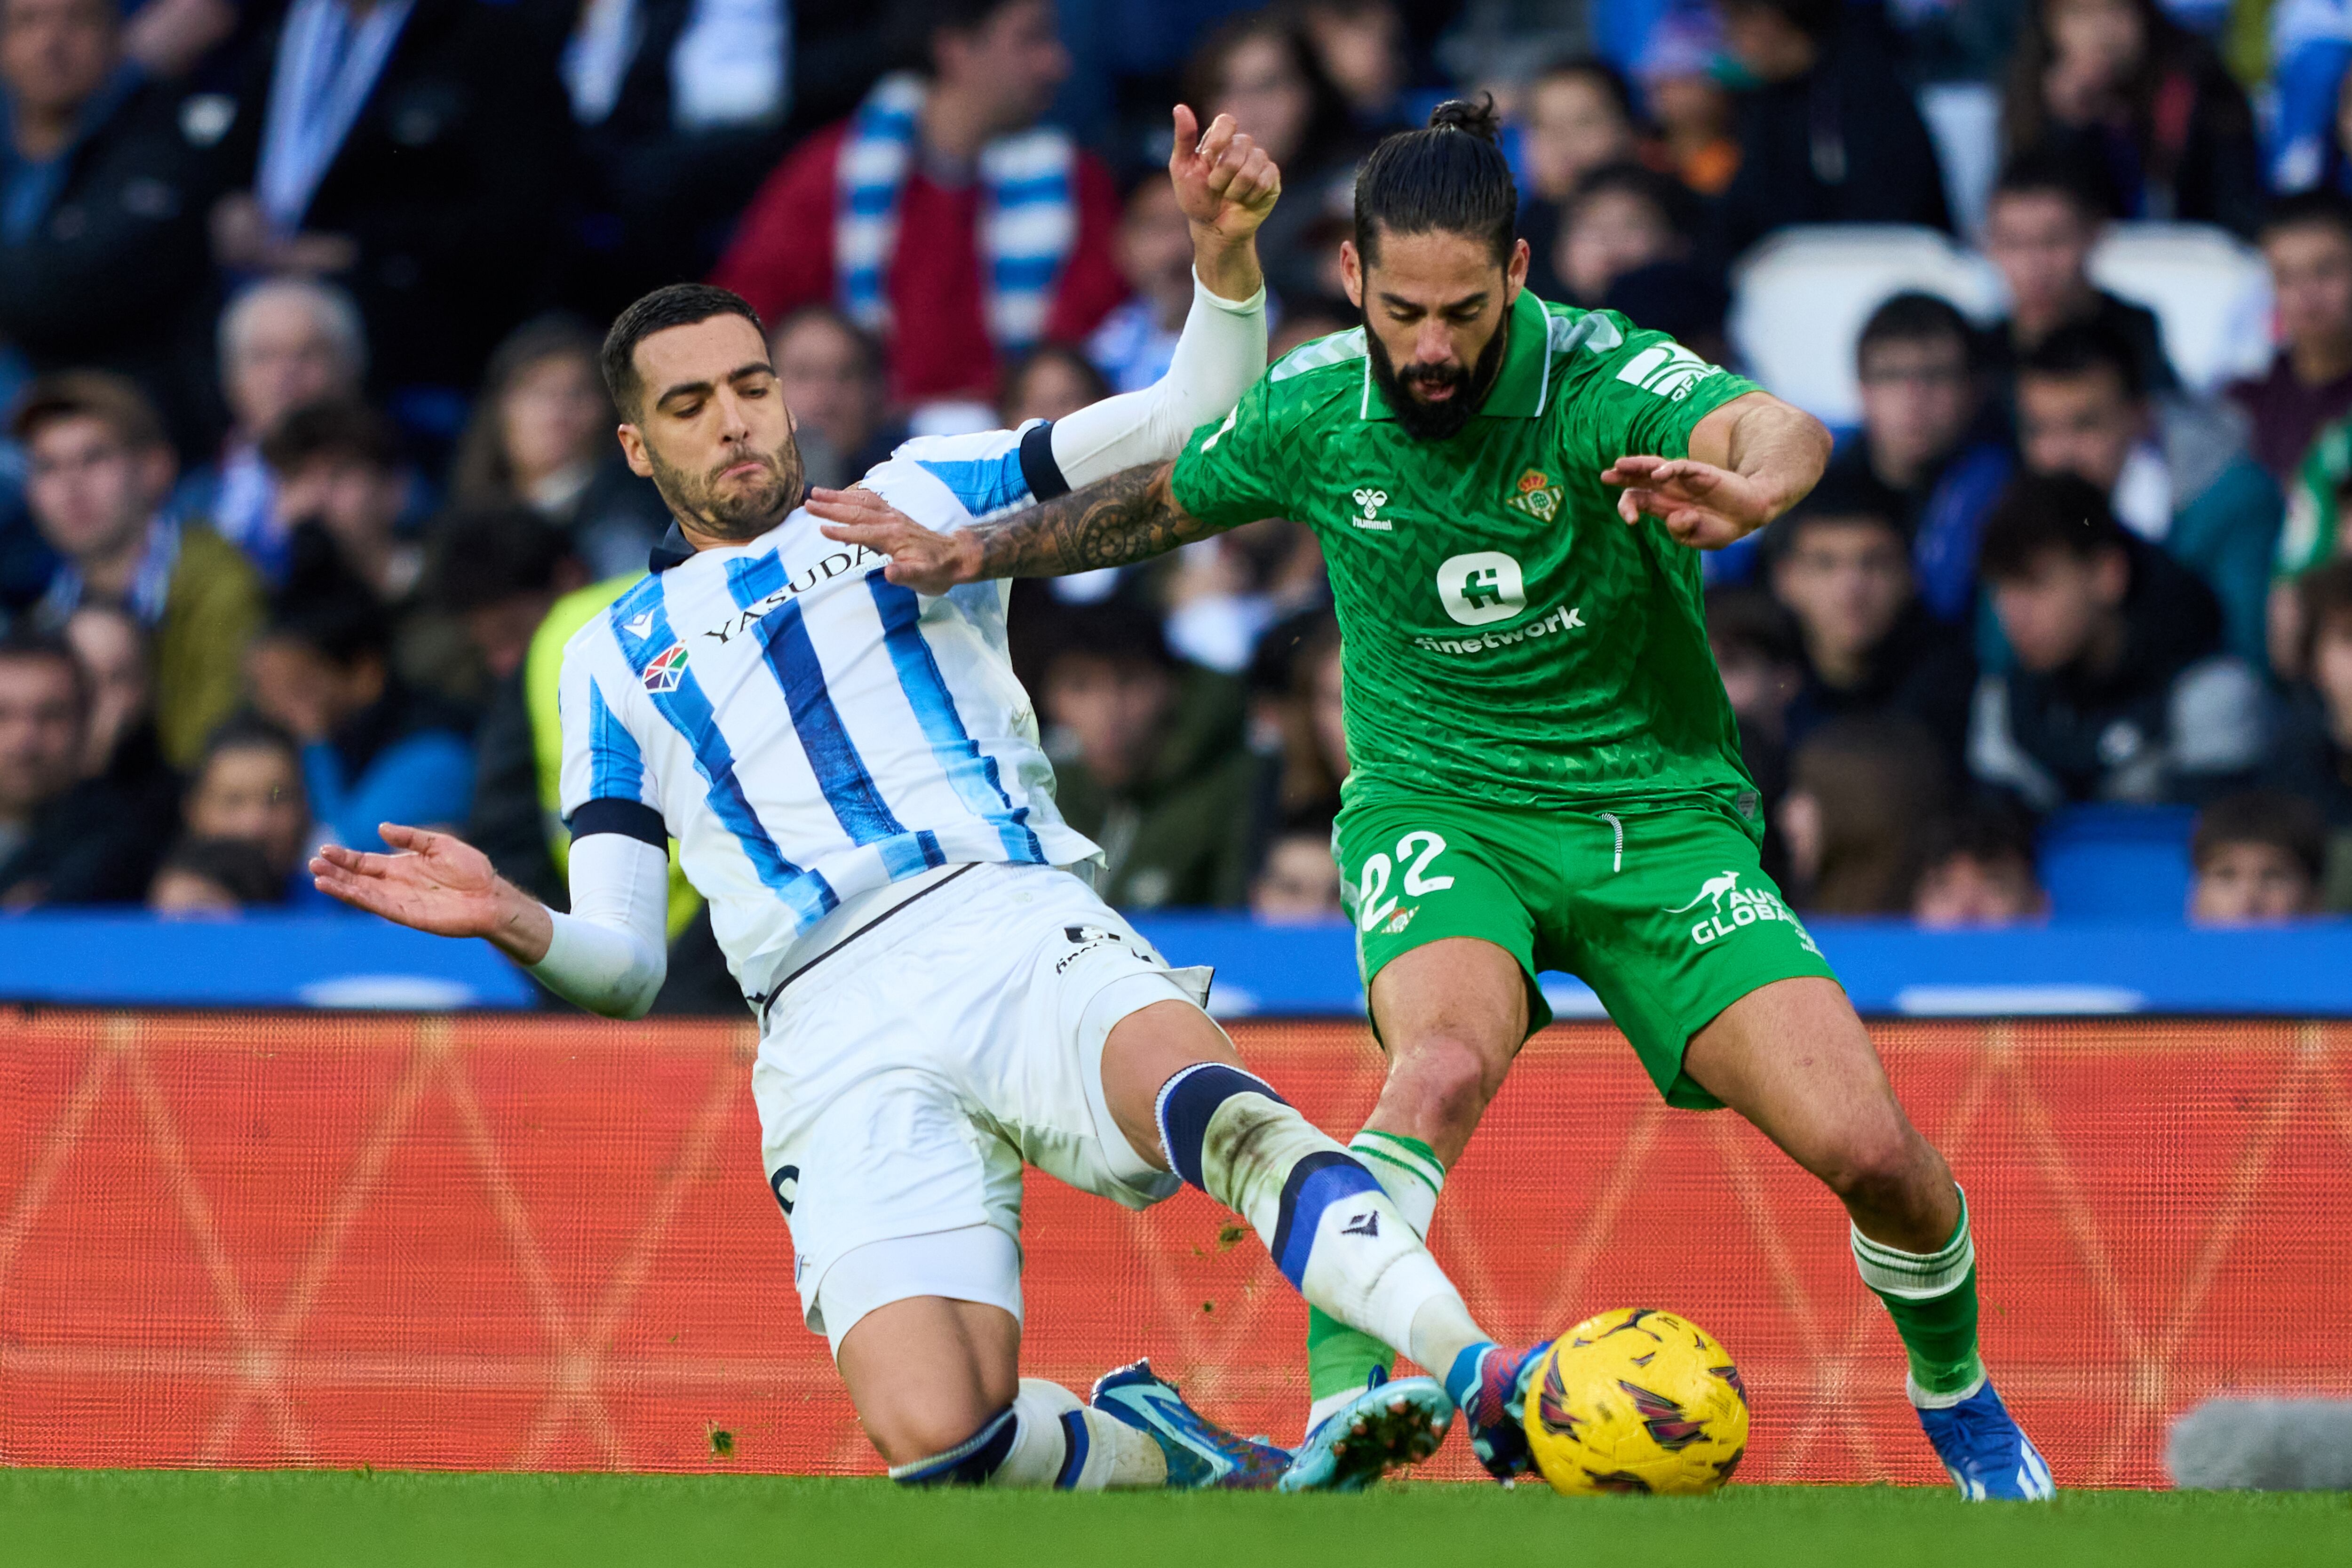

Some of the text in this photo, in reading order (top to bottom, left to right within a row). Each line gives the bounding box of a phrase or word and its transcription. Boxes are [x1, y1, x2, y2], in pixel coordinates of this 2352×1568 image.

[1352, 514, 1392, 531] hummel
[700, 543, 886, 645] YASUDA
[1414, 605, 1586, 654] finetwork
[1360, 830, 1455, 932] 22
